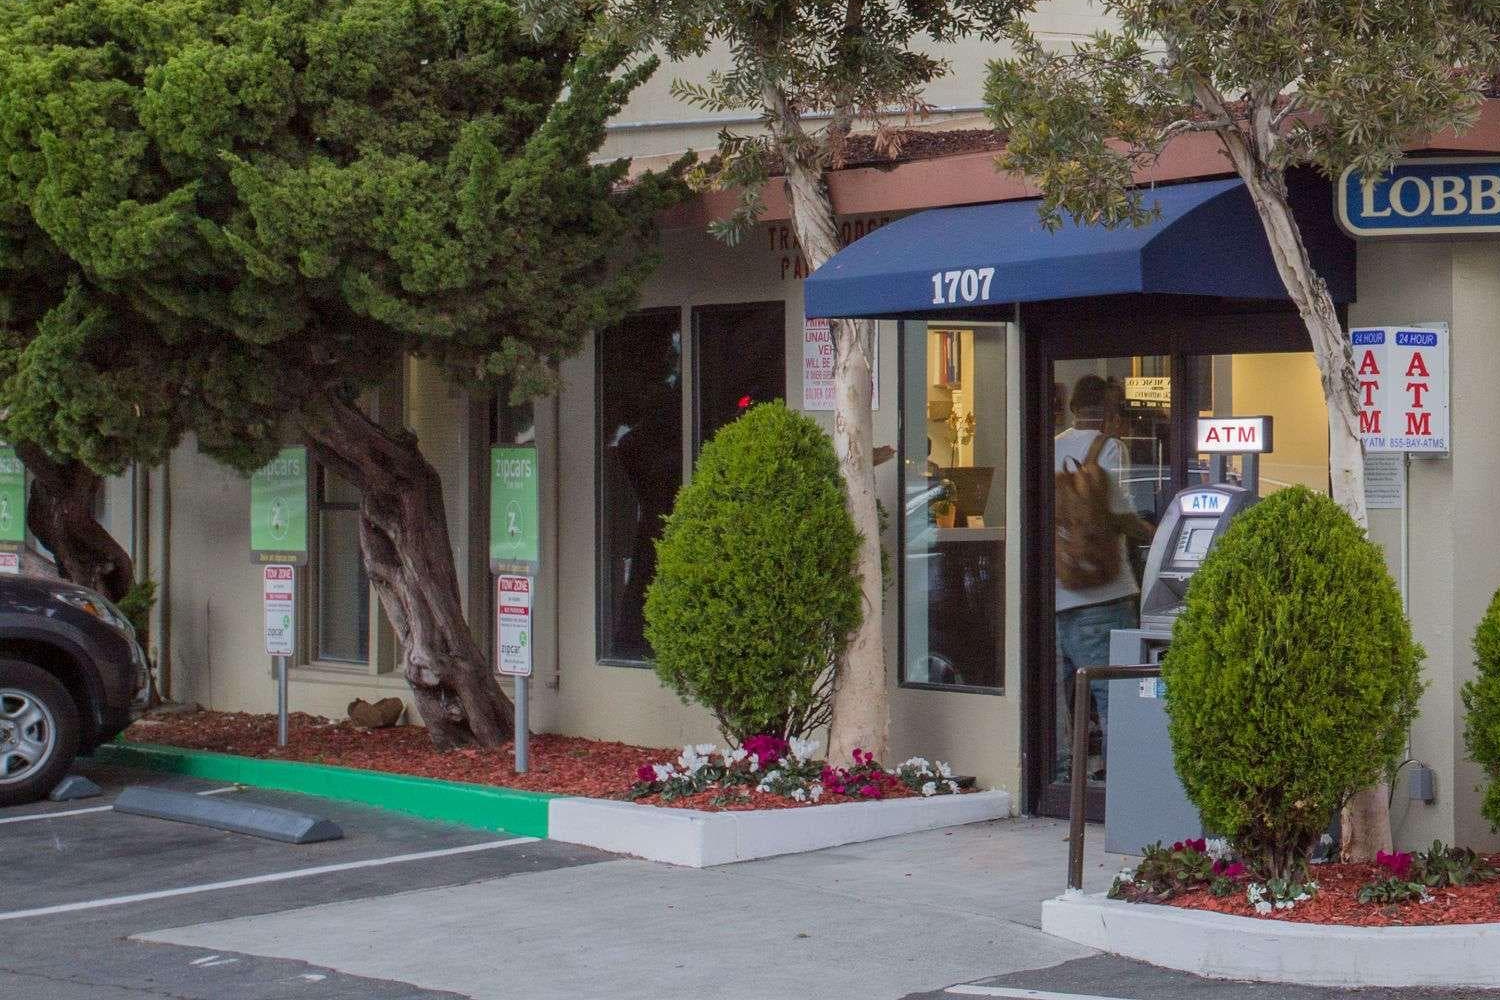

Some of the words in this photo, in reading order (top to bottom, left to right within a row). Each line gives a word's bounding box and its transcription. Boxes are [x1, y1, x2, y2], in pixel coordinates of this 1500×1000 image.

[931, 267, 996, 304] 1707
[805, 331, 831, 343] UNAU
[1354, 335, 1362, 344] 24
[1363, 333, 1383, 344] HOUR
[1399, 334, 1408, 344] 24
[1410, 334, 1434, 345] HOUR
[1358, 350, 1381, 434] ATM
[1405, 352, 1431, 436] ATM
[1205, 426, 1256, 442] ATM
[1369, 438, 1385, 448] ATM
[1389, 438, 1445, 448] 855-BAY-ATMS
[496, 455, 532, 480] zipcars
[1192, 495, 1218, 509] ATM
[501, 579, 513, 590] TOW
[514, 580, 528, 591] ZONE
